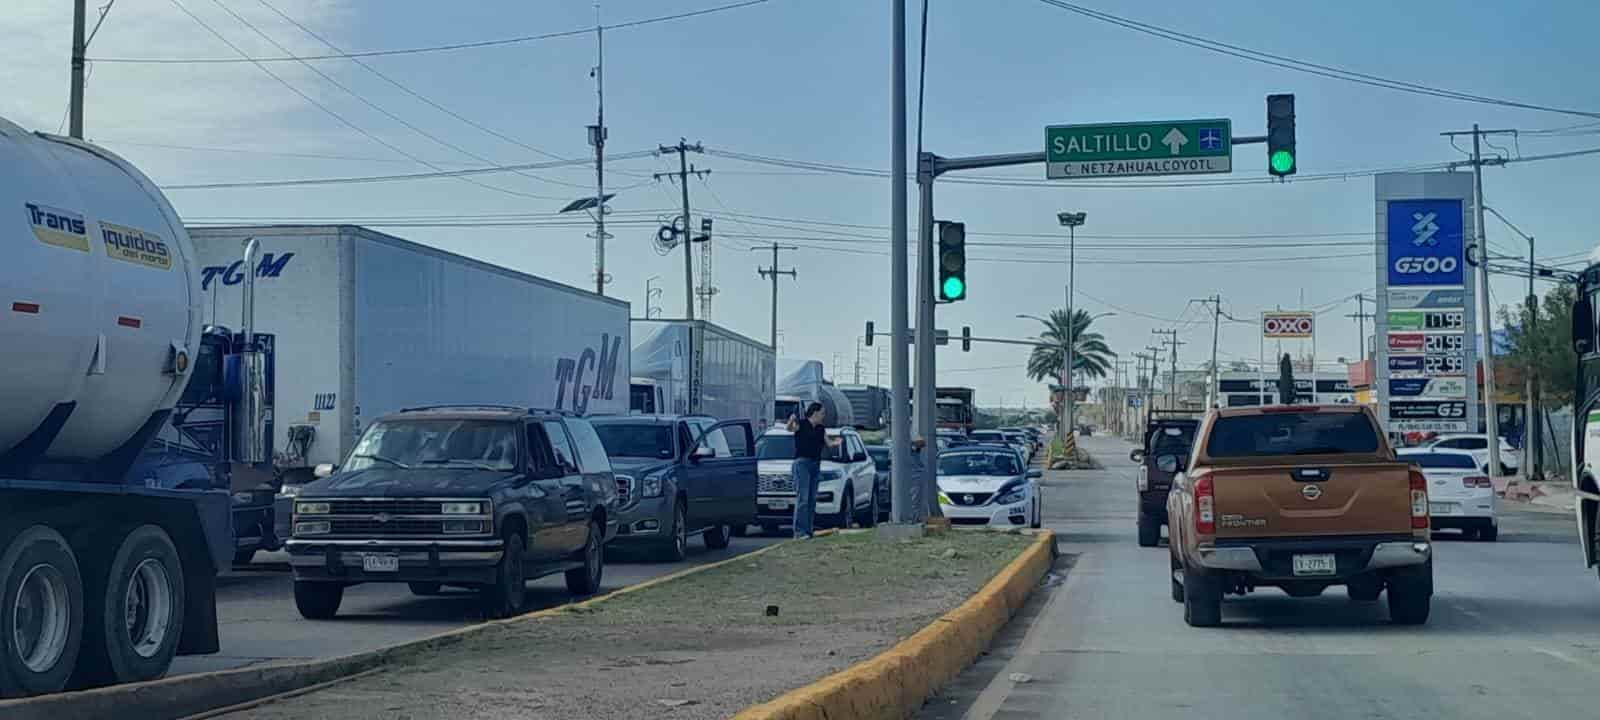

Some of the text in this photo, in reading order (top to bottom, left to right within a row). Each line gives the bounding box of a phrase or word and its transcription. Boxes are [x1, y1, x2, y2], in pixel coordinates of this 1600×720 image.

[1053, 133, 1151, 154] SALTILLO
[1081, 159, 1214, 174] NETZAHUALCOYOTL
[25, 203, 86, 235] Trans
[122, 249, 168, 265] del norte
[1395, 256, 1457, 273] G500
[201, 252, 295, 290] TGM
[1264, 318, 1312, 333] OXXO
[555, 333, 621, 414] TGM
[314, 393, 336, 410] 11122
[1438, 402, 1465, 417] G5
